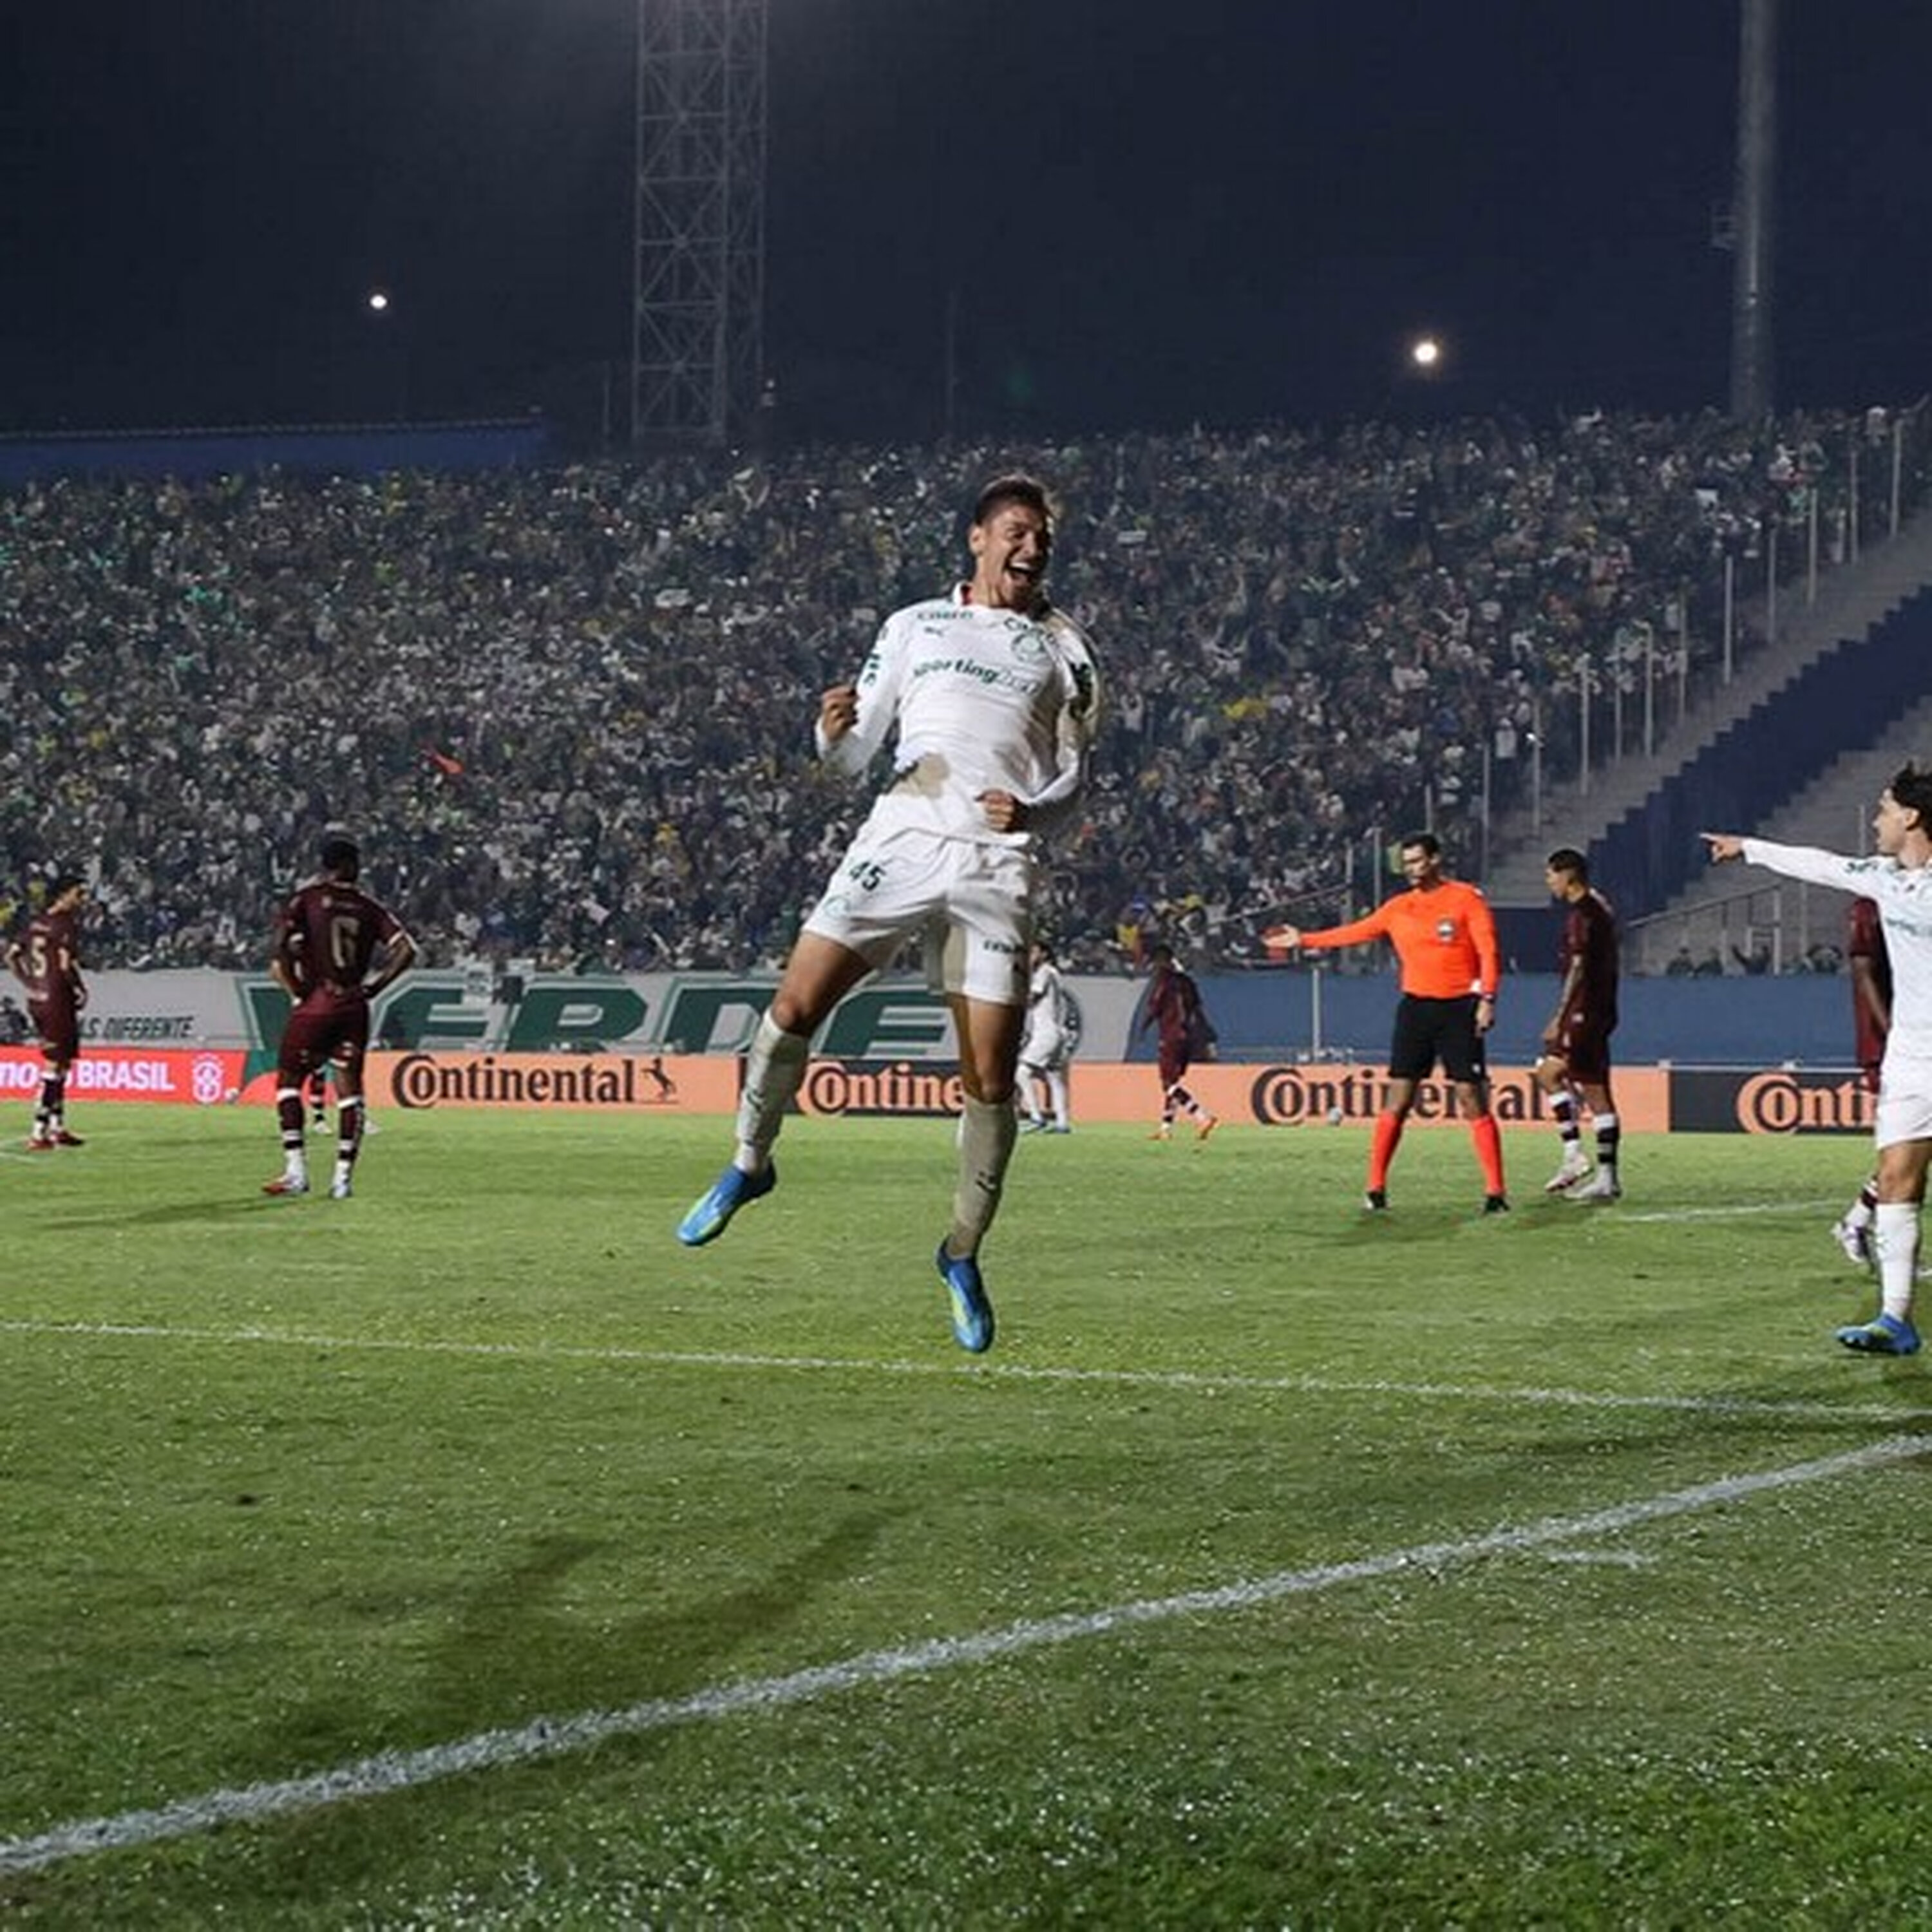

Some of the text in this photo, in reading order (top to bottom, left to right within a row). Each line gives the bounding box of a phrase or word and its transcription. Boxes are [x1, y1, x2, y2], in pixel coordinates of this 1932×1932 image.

[849, 860, 887, 892] 45
[31, 936, 48, 978] 5
[330, 915, 360, 969] 6
[76, 1059, 175, 1091] BRASIL
[392, 1054, 635, 1108] Continental
[796, 1061, 967, 1118] Contine
[1251, 1067, 1546, 1126] Contieal
